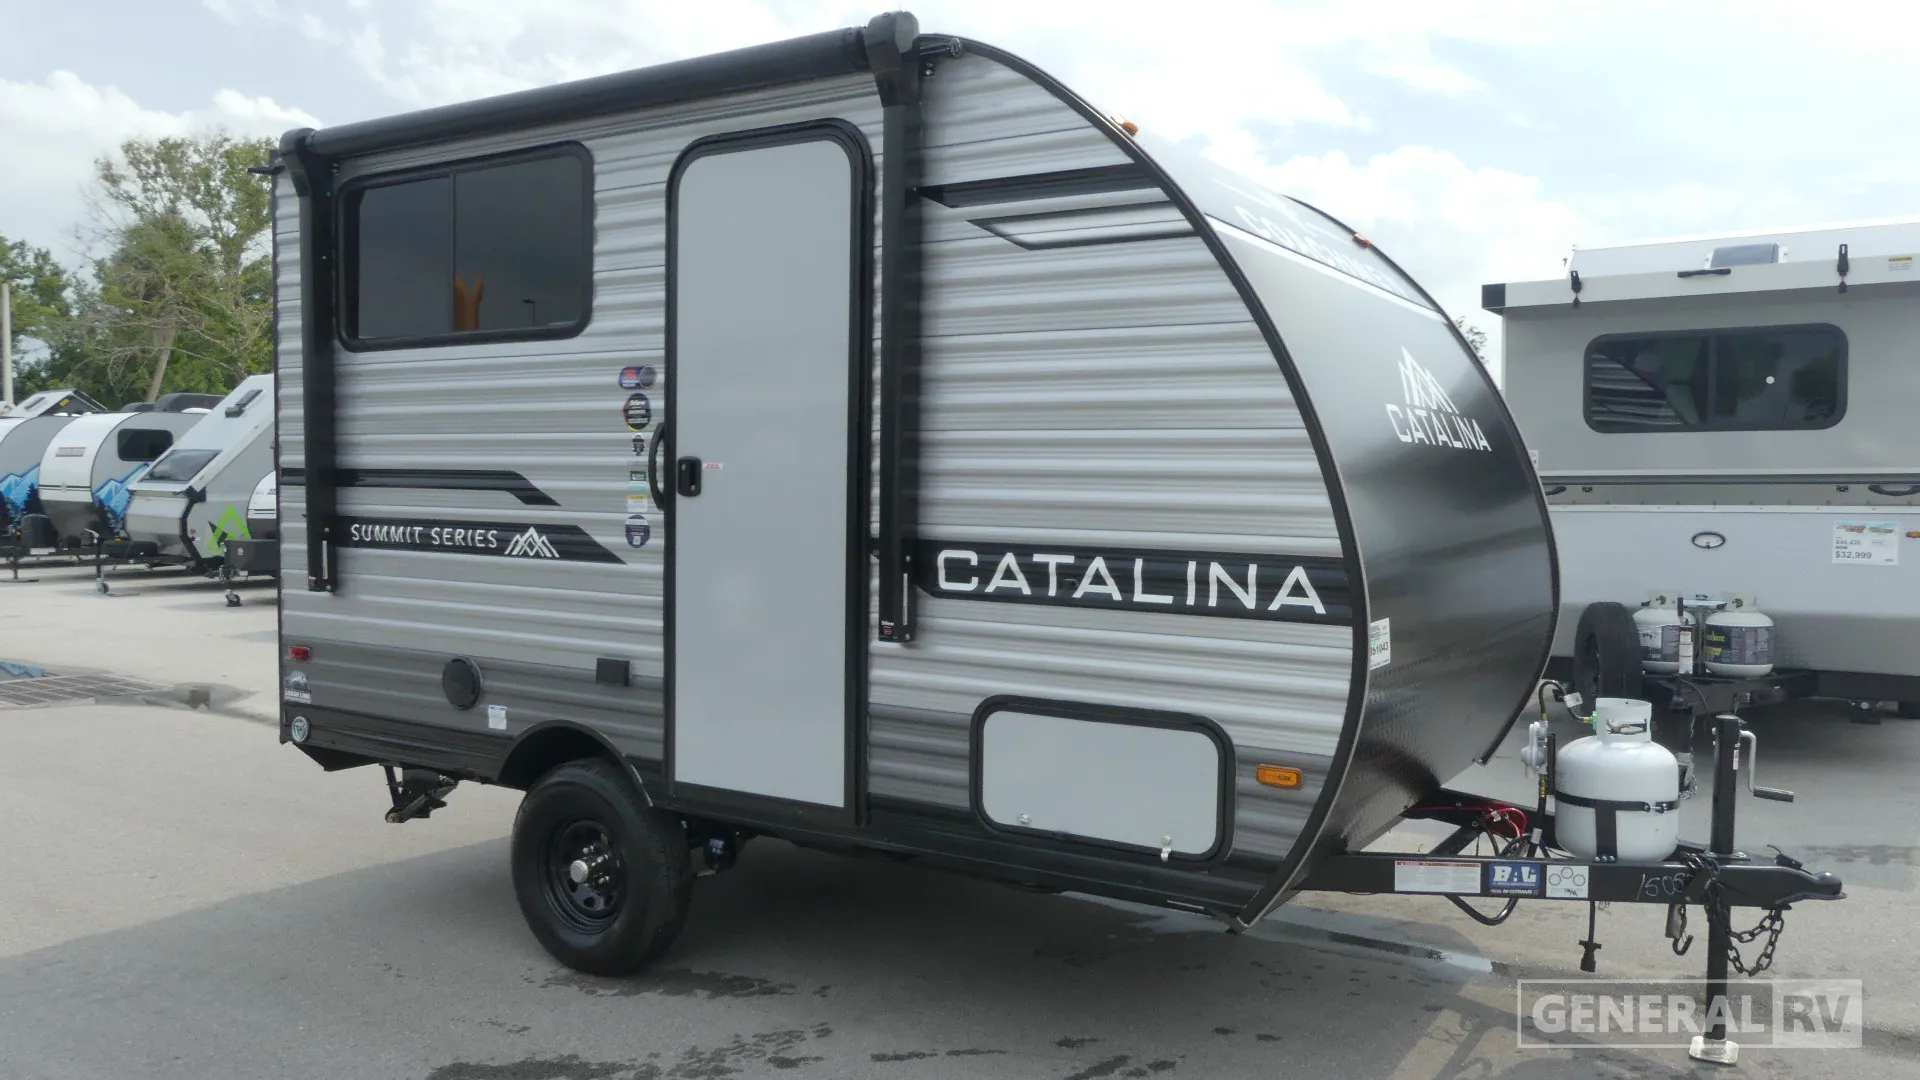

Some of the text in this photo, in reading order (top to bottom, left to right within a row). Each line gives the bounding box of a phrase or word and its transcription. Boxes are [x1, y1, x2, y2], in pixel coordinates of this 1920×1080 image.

[1386, 403, 1492, 452] CATALINA
[350, 523, 498, 548] SUMMIT SERIES
[1835, 551, 1872, 560] $32,999
[936, 549, 1327, 615] CATALINA
